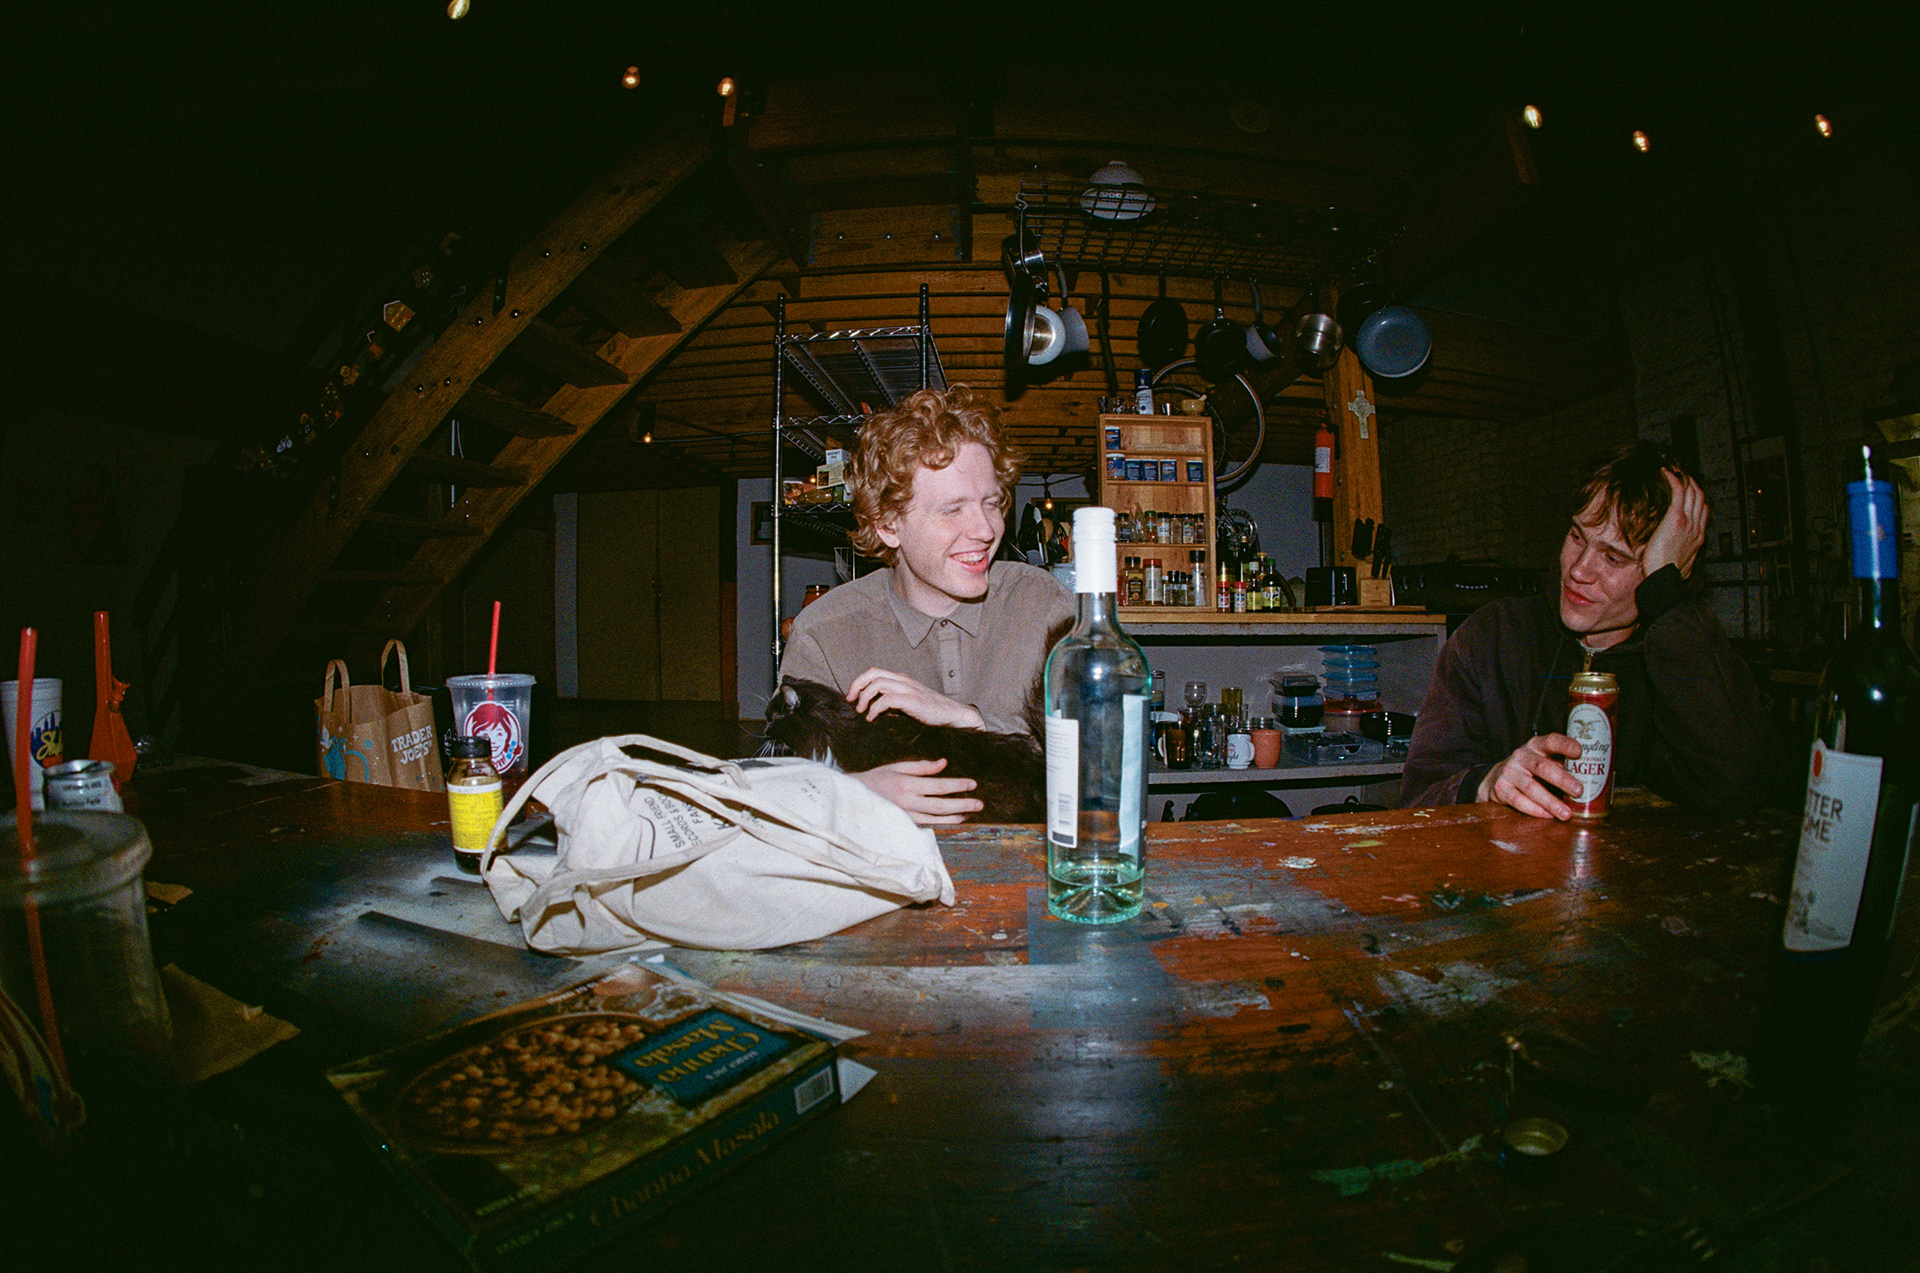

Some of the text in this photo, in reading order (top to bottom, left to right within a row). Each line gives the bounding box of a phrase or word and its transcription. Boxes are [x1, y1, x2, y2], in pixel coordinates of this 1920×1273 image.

[391, 725, 433, 753] TRADER
[400, 740, 430, 765] JOE'S
[1582, 741, 1610, 755] ngling
[1808, 790, 1843, 822] TTER
[644, 797, 686, 849] SMALL FRIEND
[674, 814, 702, 847] ECORDS
[634, 1020, 735, 1067] Masala
[657, 1032, 760, 1083] Channa
